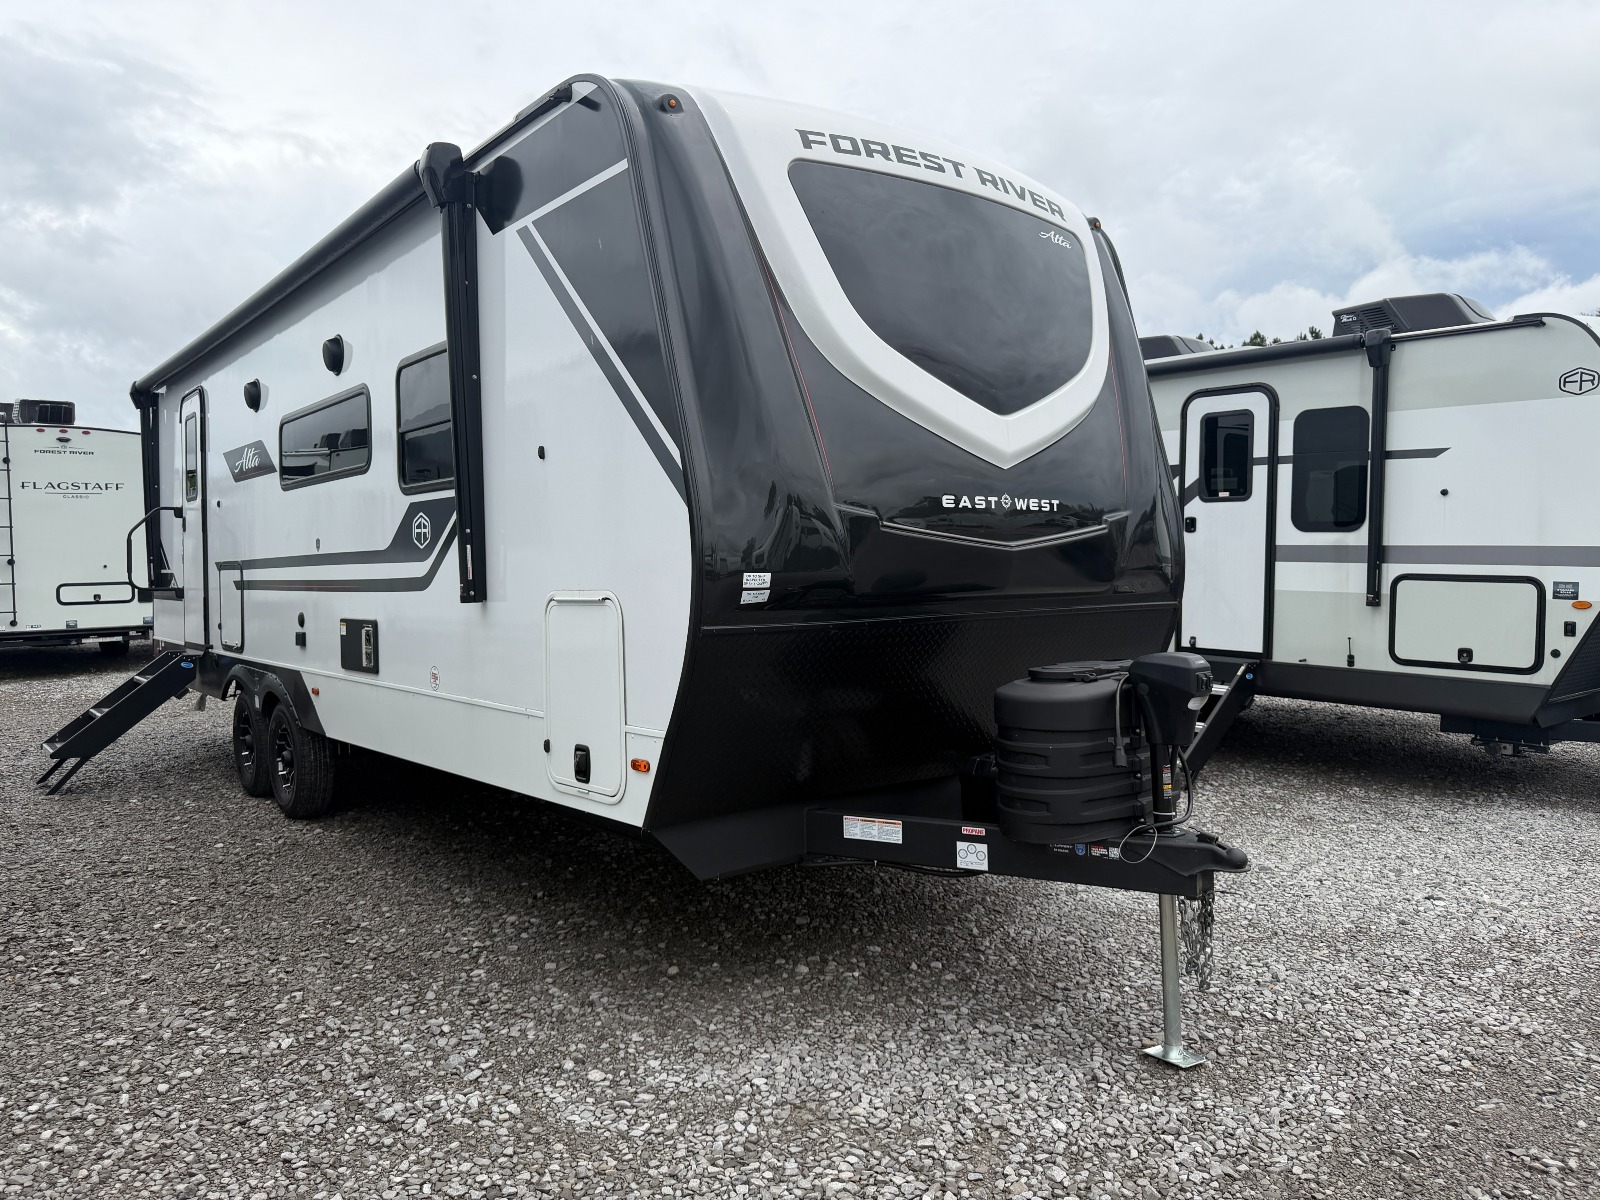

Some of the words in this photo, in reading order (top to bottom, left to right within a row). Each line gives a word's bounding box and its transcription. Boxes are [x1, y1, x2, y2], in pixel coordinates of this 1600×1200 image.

[794, 128, 966, 179] FOREST
[972, 166, 1067, 223] RIVER
[1038, 230, 1073, 249] Alta
[233, 446, 261, 473] Alta
[19, 481, 125, 491] FLAGSTAFF
[941, 494, 999, 509] EAST
[1014, 497, 1060, 512] WEST
